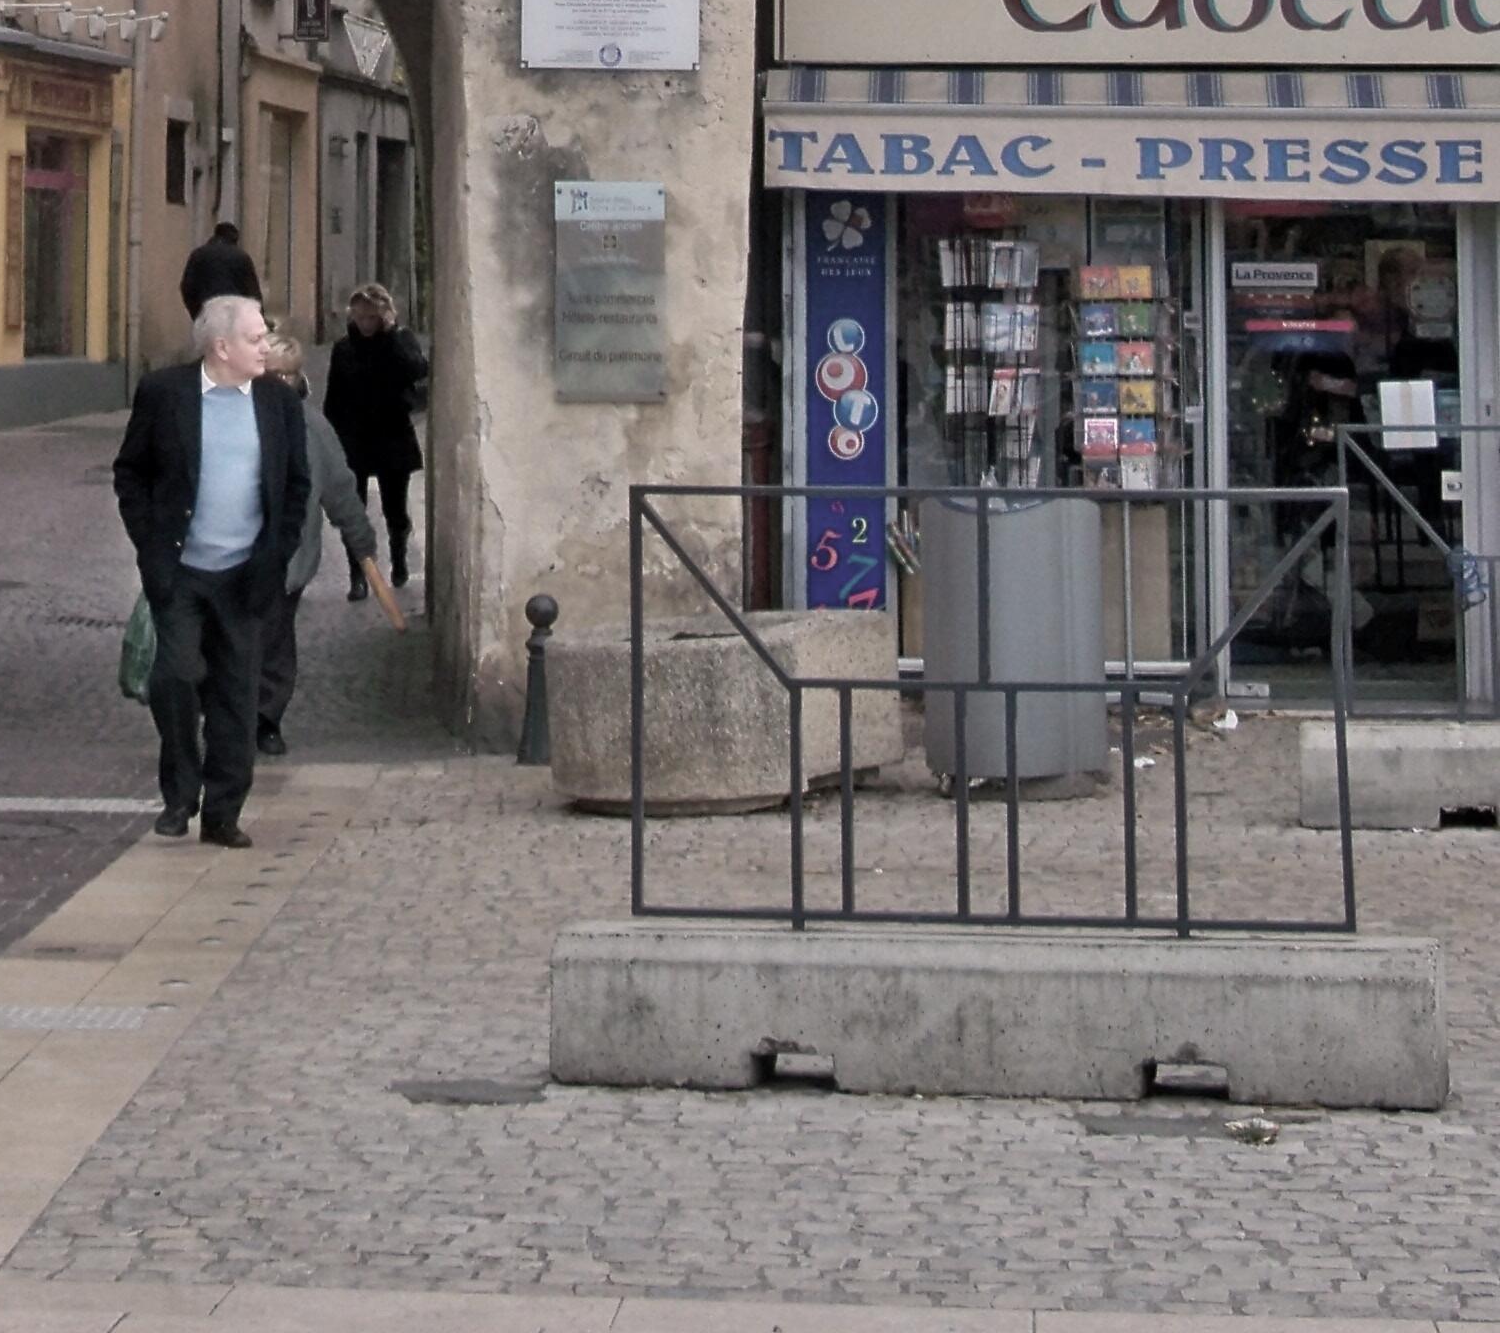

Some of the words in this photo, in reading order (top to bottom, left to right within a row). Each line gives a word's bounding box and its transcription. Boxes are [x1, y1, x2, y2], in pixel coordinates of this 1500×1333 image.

[767, 130, 1056, 179] TABAC
[1136, 137, 1483, 185] PRESSE
[1235, 269, 1251, 280] La
[1253, 269, 1314, 281] Provence
[852, 518, 868, 543] 2
[810, 530, 842, 570] 5
